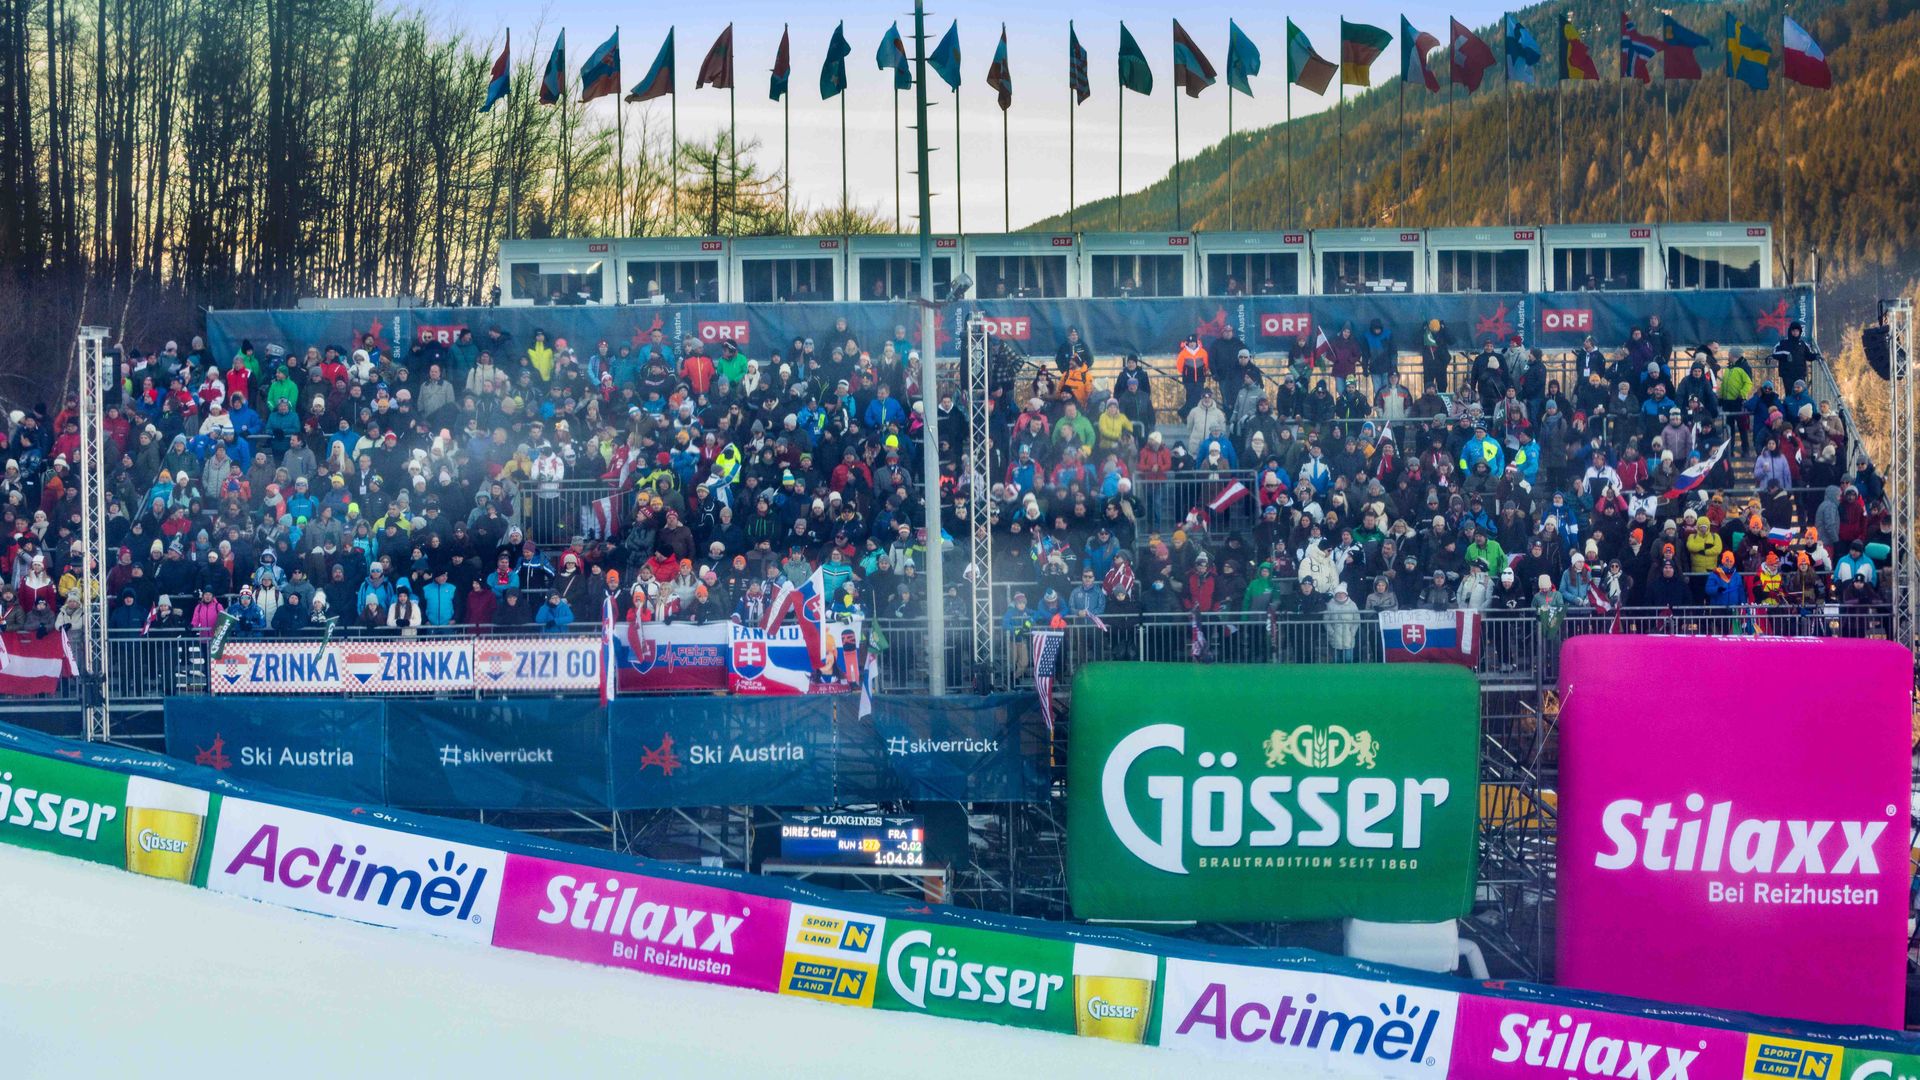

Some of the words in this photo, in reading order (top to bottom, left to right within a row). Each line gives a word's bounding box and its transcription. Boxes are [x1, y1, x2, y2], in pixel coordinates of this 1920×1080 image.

[1238, 304, 1246, 332] Austria
[1517, 301, 1525, 328] Austria
[1546, 313, 1589, 328] ORF
[393, 316, 401, 343] Austria
[674, 312, 682, 340] Austria
[702, 325, 746, 339] ORF
[986, 321, 1027, 335] ORF
[1265, 318, 1309, 333] ORF
[393, 346, 401, 358] Ski
[250, 653, 340, 682] ZRINKA
[381, 650, 471, 681] ZRINKA
[515, 650, 558, 678] ZIZI
[567, 650, 596, 677] GO
[241, 746, 272, 765] Ski
[278, 747, 353, 766] Austria
[440, 744, 553, 767] #skiverrückt
[689, 745, 721, 765] Ski
[729, 743, 804, 763] Austria
[887, 736, 998, 756] #skiverrückt
[1102, 723, 1450, 875] Gösser
[823, 815, 882, 825] LONGINES
[138, 828, 188, 853] Gösser
[782, 826, 809, 837] DIREZ
[811, 827, 837, 838] Clara
[888, 829, 907, 839] FRA
[1595, 793, 1889, 875] Stilaxx
[838, 840, 856, 850] RUN
[897, 841, 921, 851] -0.02
[875, 852, 923, 865] 1:04.84
[1199, 856, 1332, 869] BRAUTRADITION
[1339, 857, 1375, 869] SEIT
[1381, 858, 1418, 870] 1860
[224, 824, 487, 922] Actimel
[1708, 881, 1744, 903] Bei
[1754, 882, 1879, 905] Reizhusten
[538, 875, 745, 955] Stilaxx
[806, 917, 840, 929] SPORT
[803, 933, 832, 945] LAND
[612, 940, 639, 961] Bei
[644, 944, 731, 976] Reizhusten
[799, 964, 833, 977] SPORT
[885, 930, 1063, 1010] Gösser
[796, 980, 825, 992] LAND
[1086, 996, 1139, 1021] Gösser
[1175, 982, 1440, 1064] Actimel
[1491, 1013, 1701, 1080] Stilaxx
[1763, 1047, 1797, 1059] SPORT
[1761, 1064, 1789, 1074] LAND
